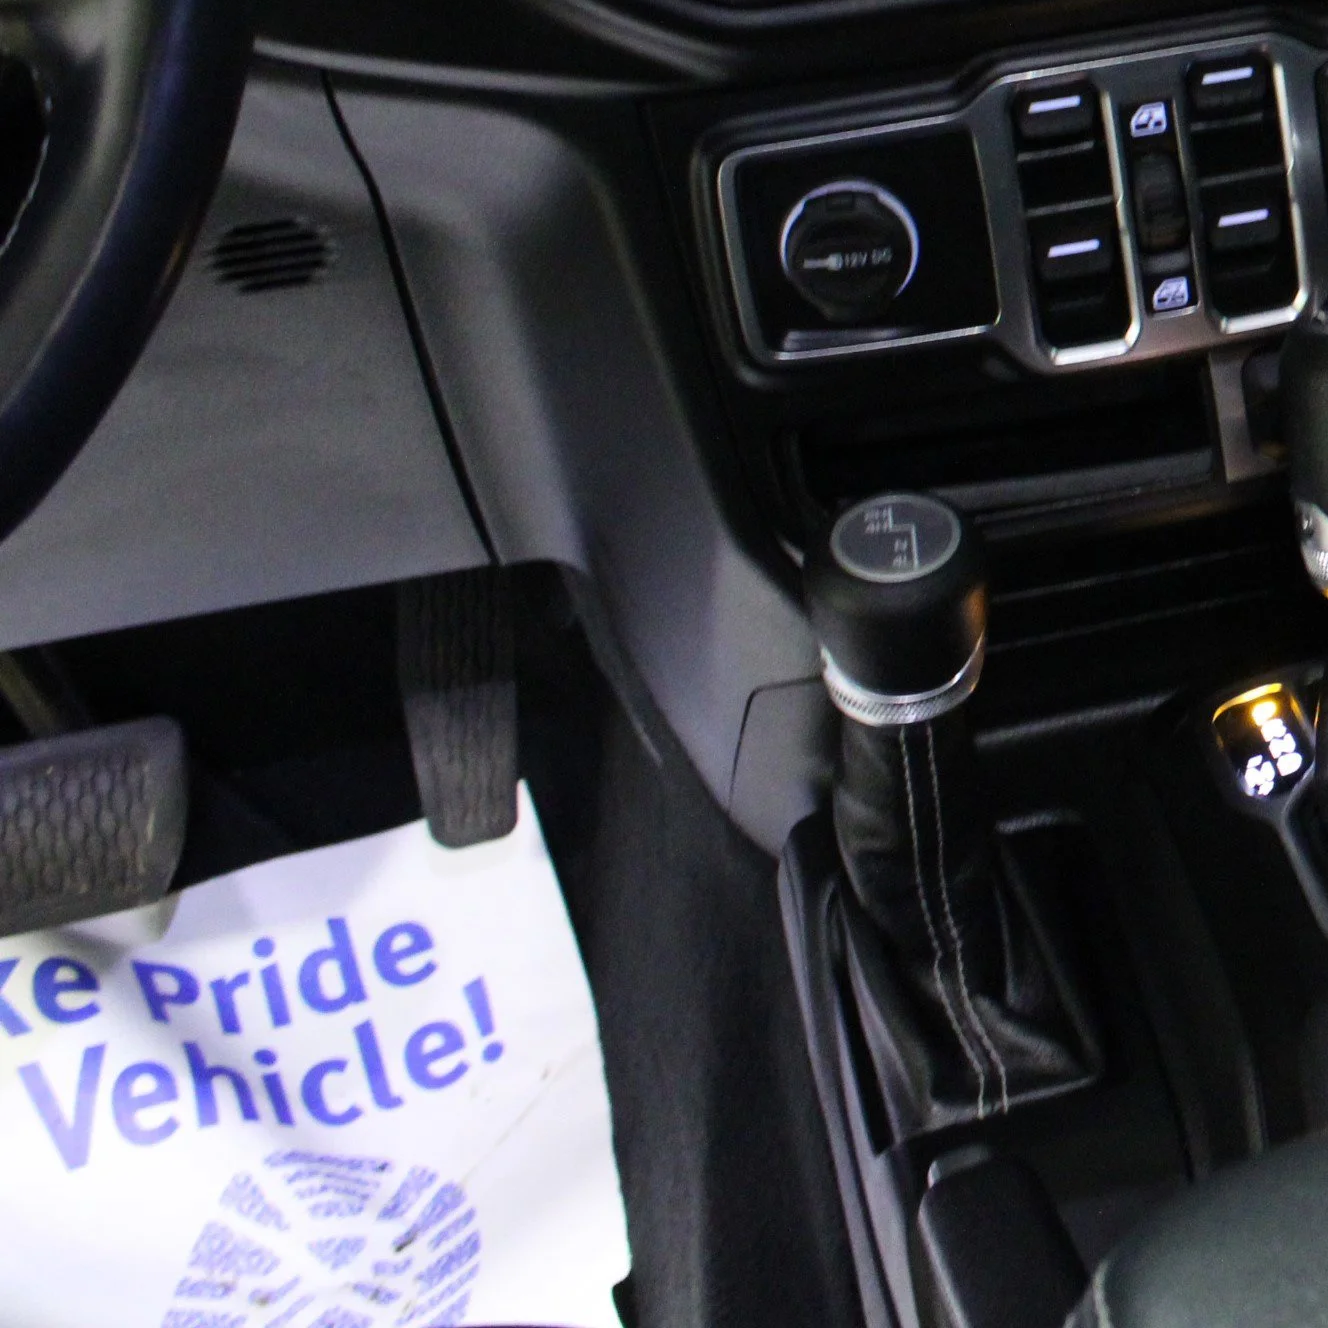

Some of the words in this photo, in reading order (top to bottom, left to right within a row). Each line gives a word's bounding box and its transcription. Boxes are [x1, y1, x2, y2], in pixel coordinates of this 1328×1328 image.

[844, 250, 868, 270] 12V
[871, 247, 894, 266] DC
[131, 916, 440, 1036] Pride
[17, 976, 505, 1172] Vehicle!
